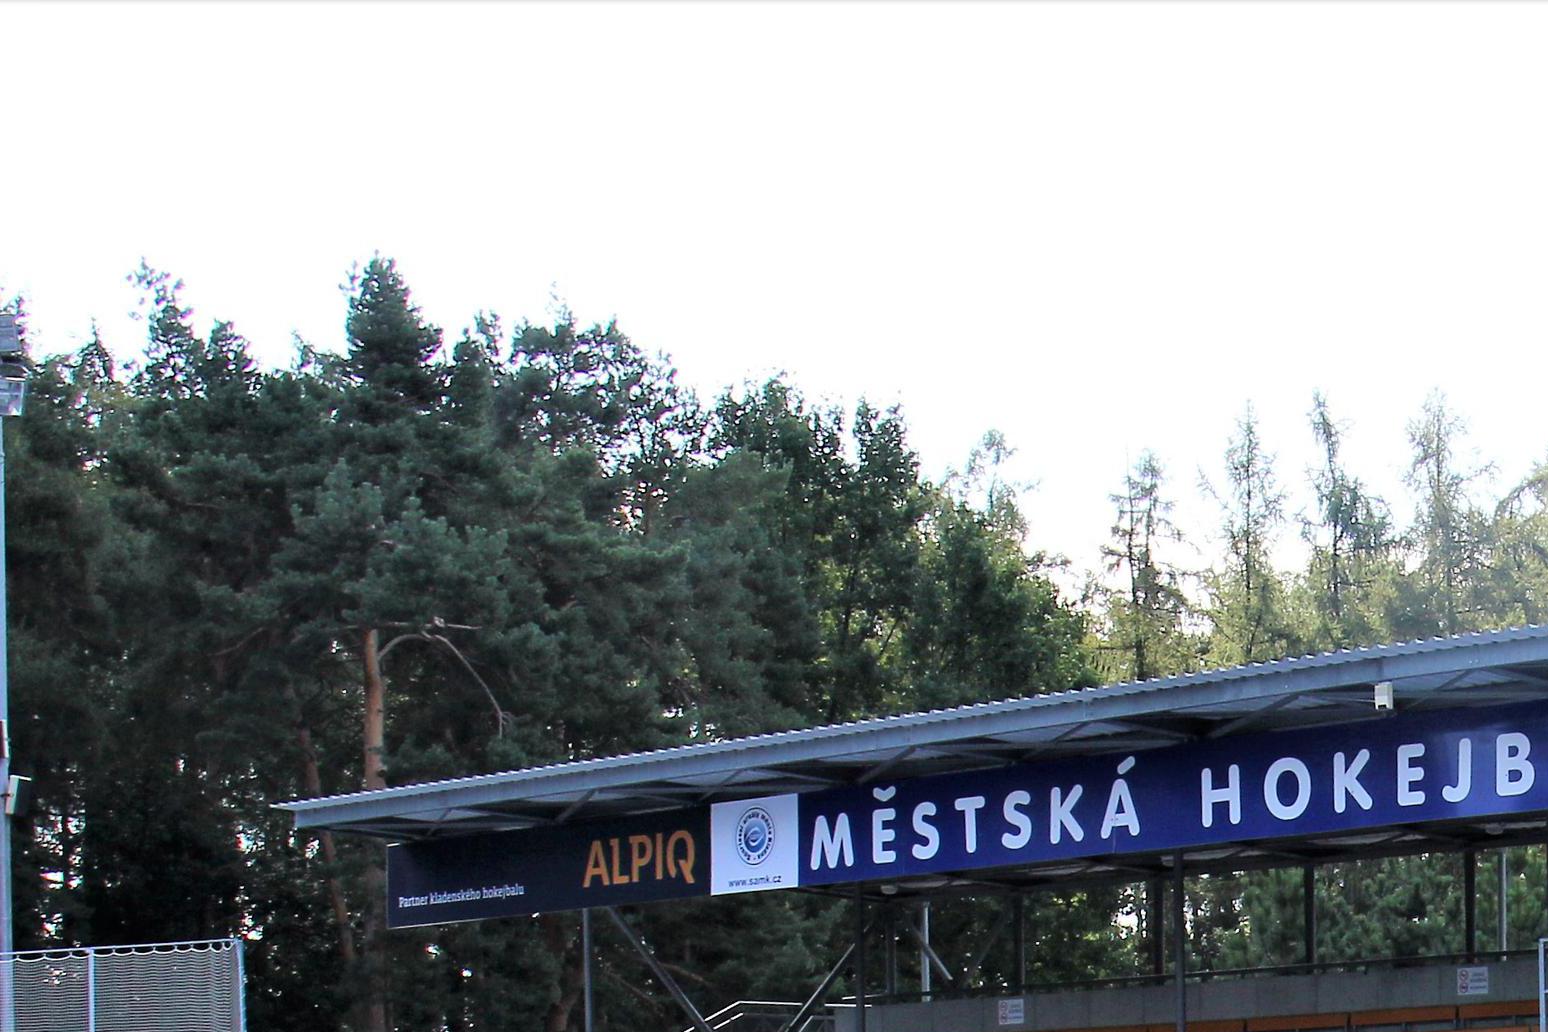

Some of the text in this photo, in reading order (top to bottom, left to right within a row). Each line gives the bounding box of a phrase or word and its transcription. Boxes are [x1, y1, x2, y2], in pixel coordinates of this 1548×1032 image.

[810, 755, 1141, 871] MĚSTSKÁ
[582, 830, 695, 888] ALPIQ
[398, 883, 525, 908] Partner kladenského hokejbalu
